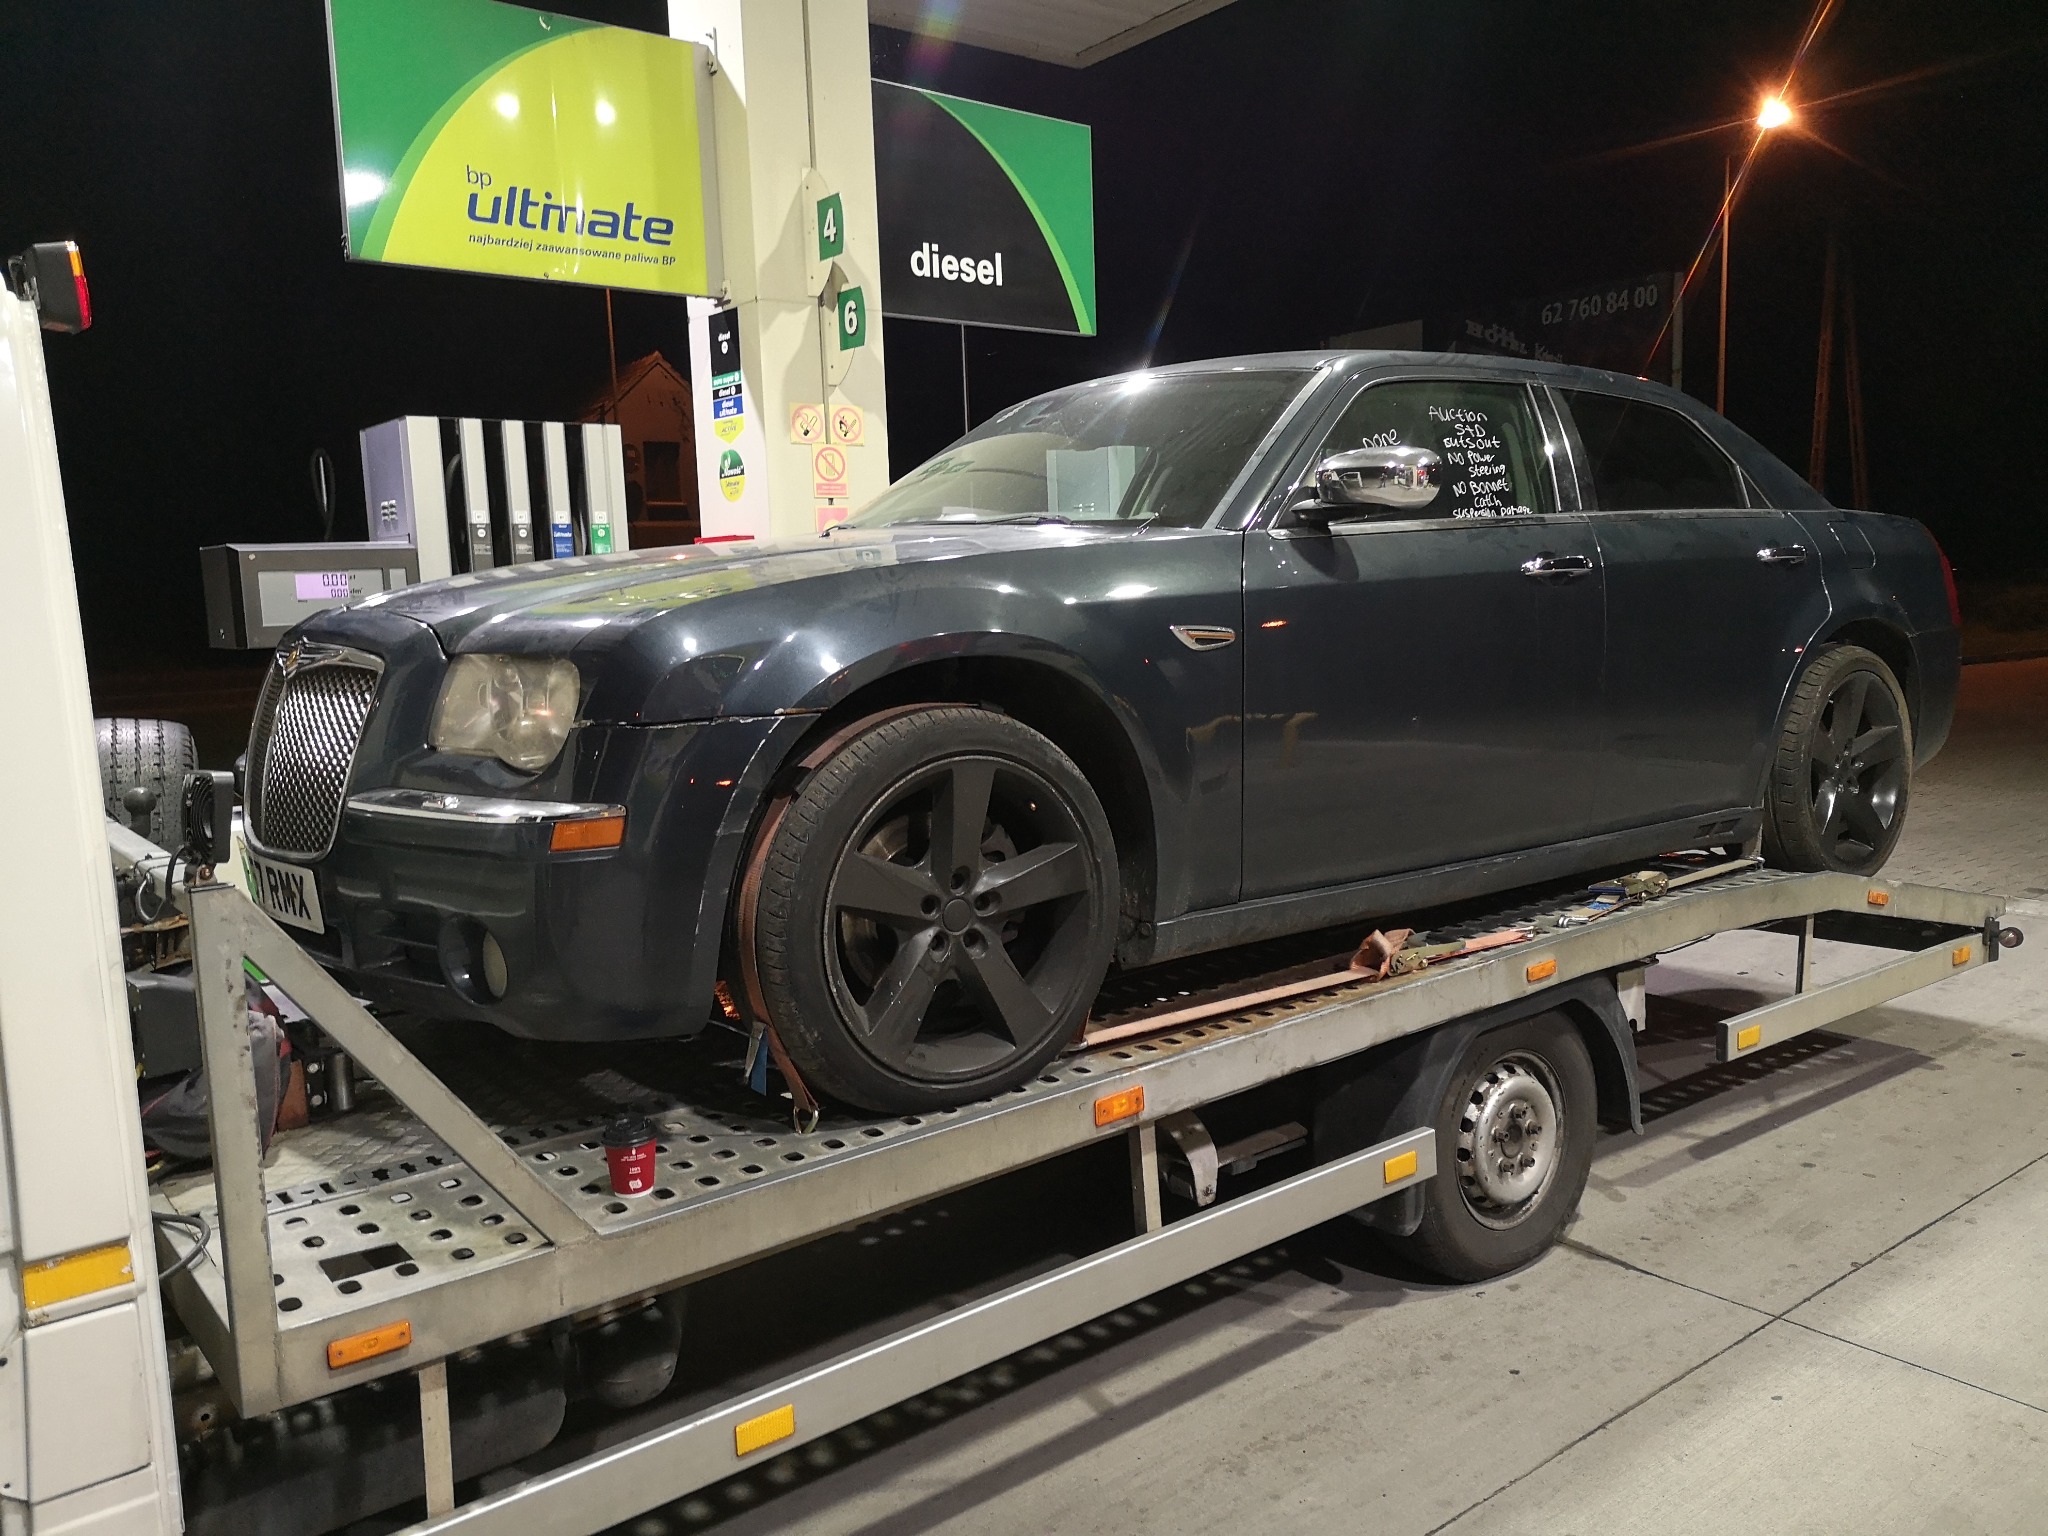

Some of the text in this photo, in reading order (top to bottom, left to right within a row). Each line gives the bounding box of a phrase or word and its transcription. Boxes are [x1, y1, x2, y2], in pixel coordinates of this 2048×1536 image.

[466, 164, 493, 190] bp
[467, 186, 675, 246] ultimate
[823, 207, 837, 243] 4
[468, 233, 676, 267] najbardziej zaawansowane paliwa BP
[910, 241, 1003, 286] diesel
[844, 300, 858, 335] 6
[1541, 283, 1658, 326] 62 760 84 00
[266, 866, 312, 921] RMX
